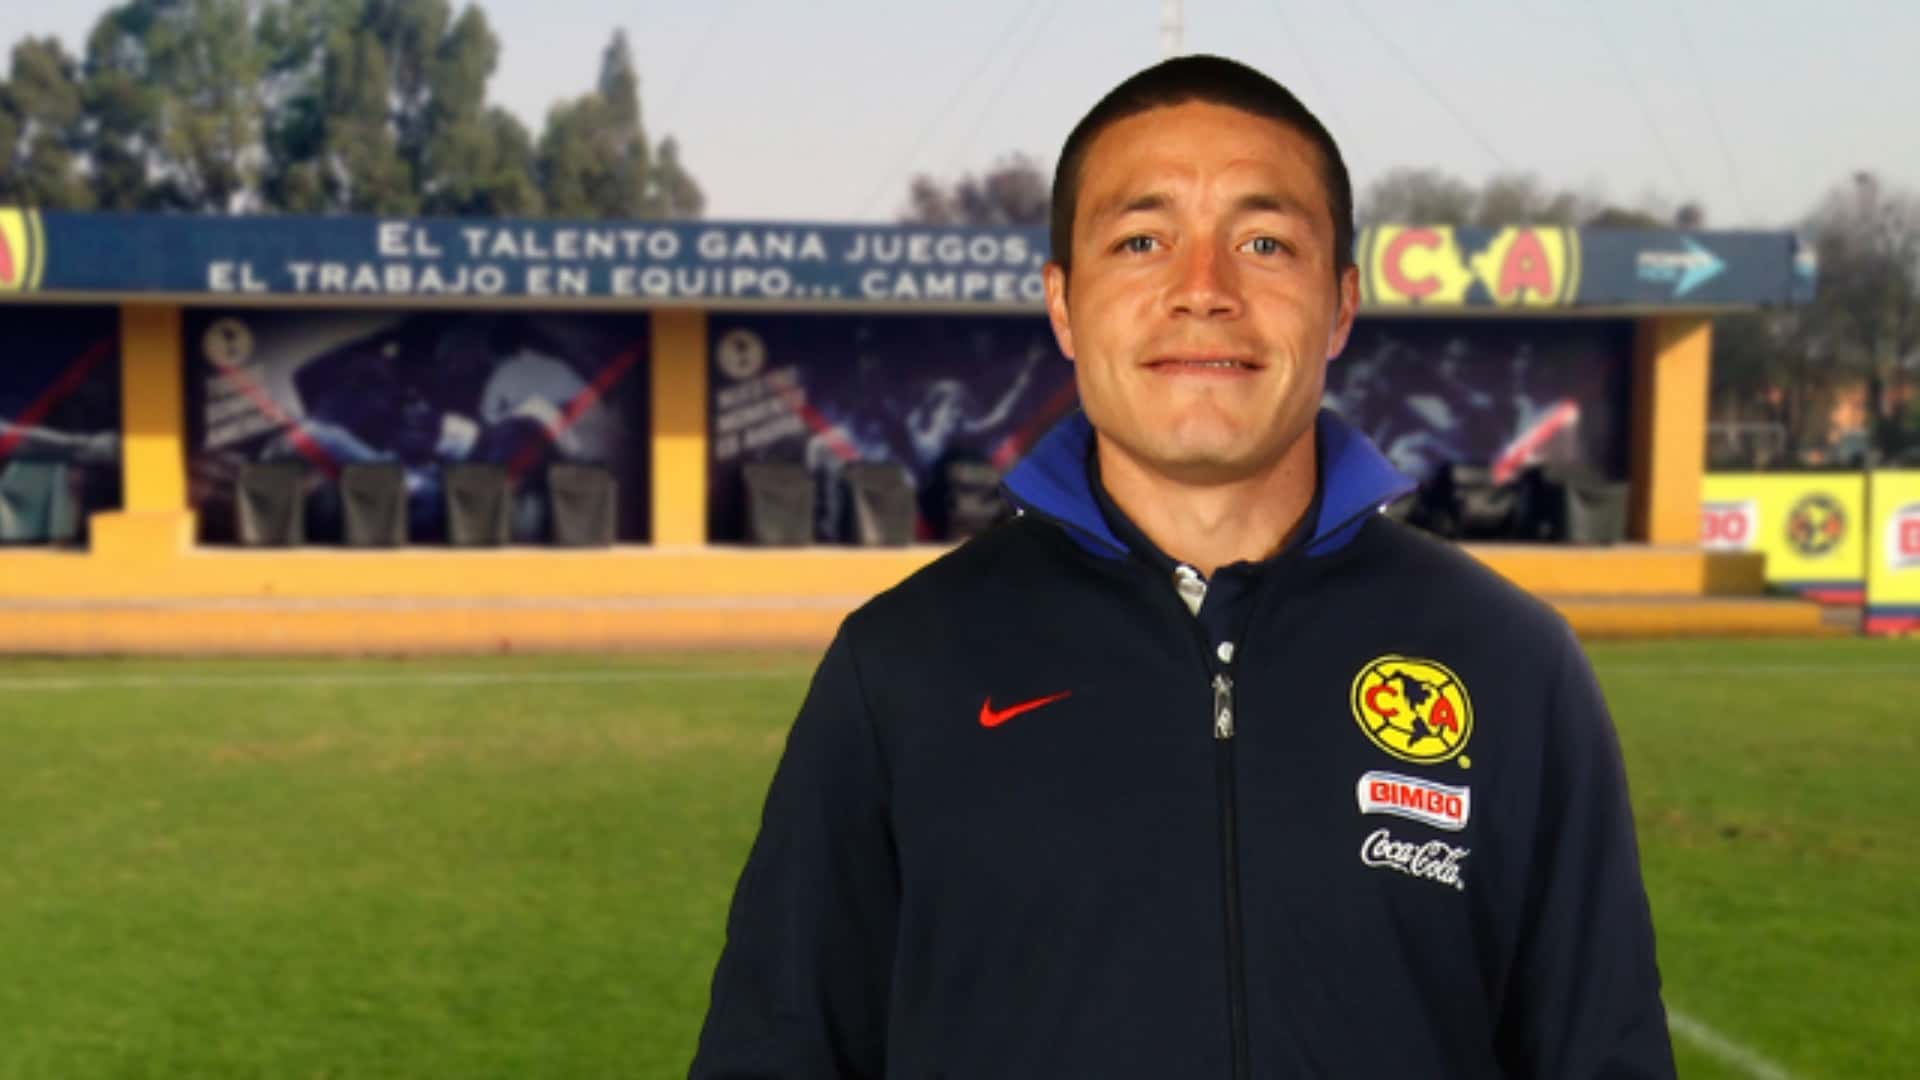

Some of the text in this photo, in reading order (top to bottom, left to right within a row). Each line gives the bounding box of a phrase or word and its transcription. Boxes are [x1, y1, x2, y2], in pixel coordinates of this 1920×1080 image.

[378, 221, 1045, 267] EL TALENTO GANA JUEGOS,
[208, 263, 267, 291] EL
[288, 264, 505, 293] TRABAJO
[526, 266, 588, 294] EN
[612, 267, 841, 298] EQUIPO...
[1370, 780, 1462, 820] BIMBO
